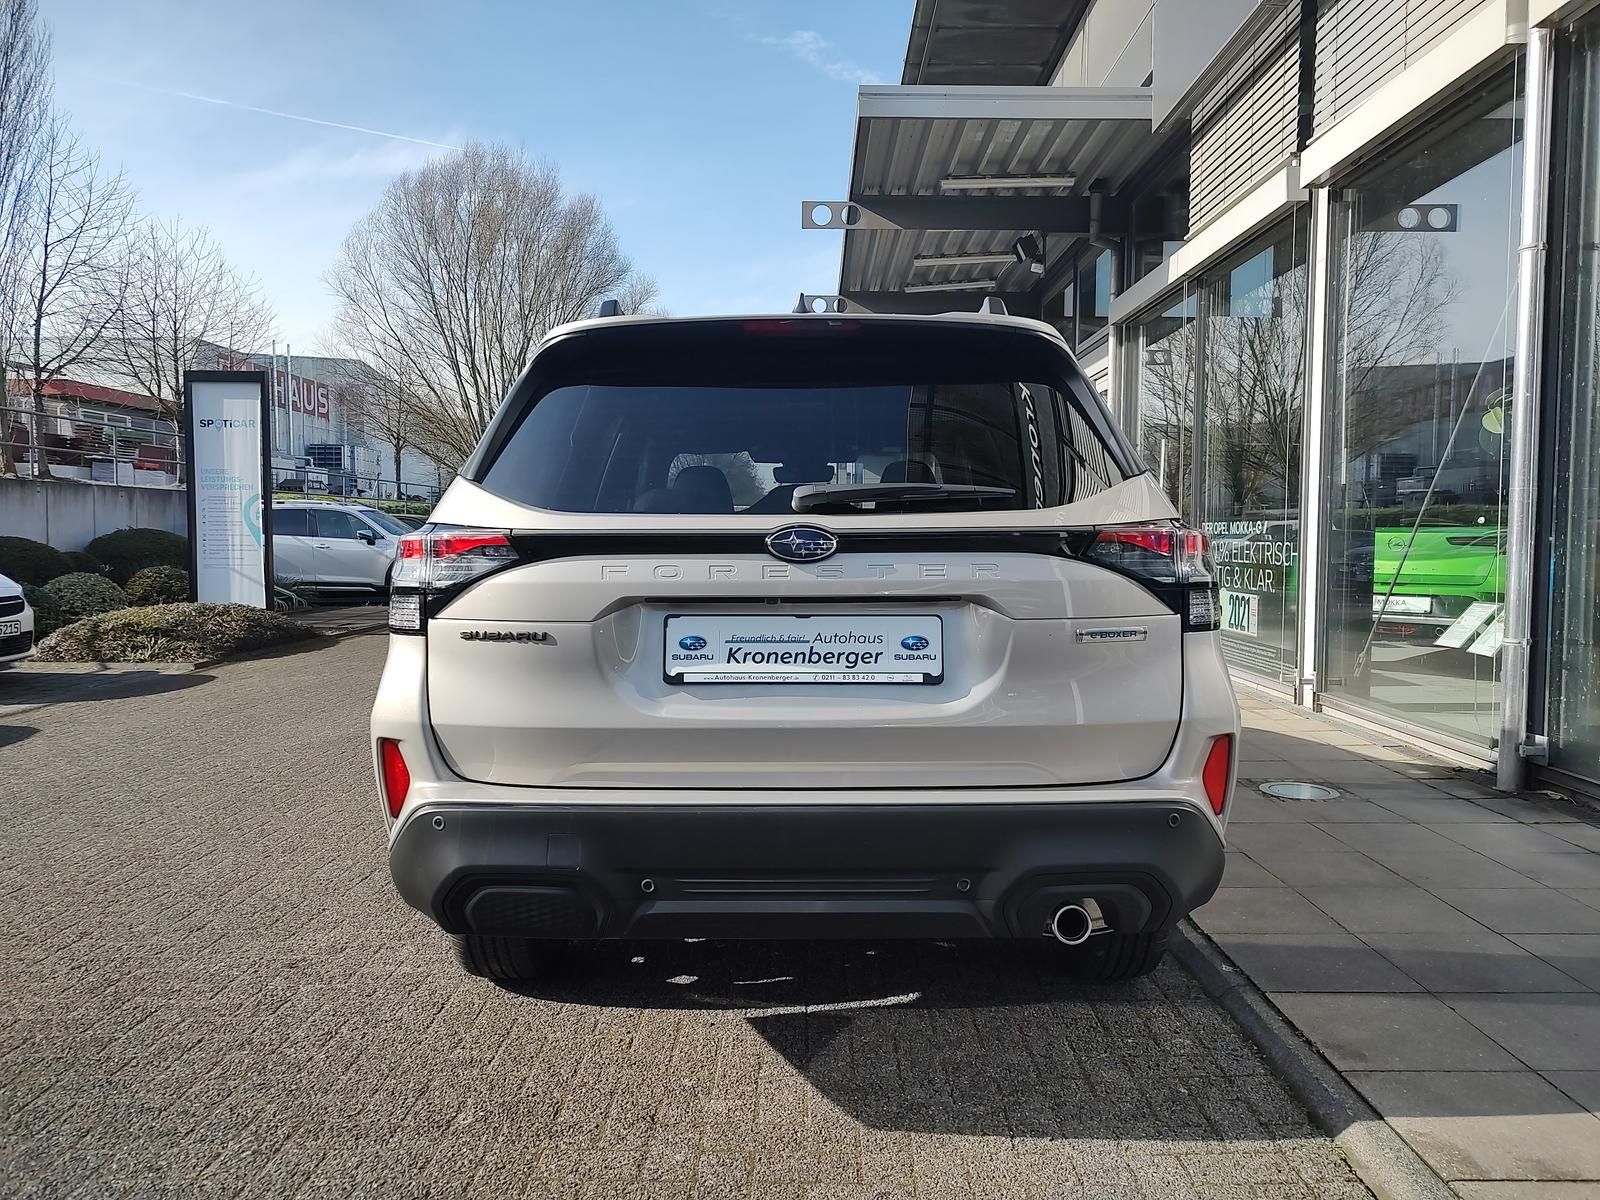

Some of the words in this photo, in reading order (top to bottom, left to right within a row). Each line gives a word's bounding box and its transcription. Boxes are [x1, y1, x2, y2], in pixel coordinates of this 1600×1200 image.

[1213, 522, 1228, 534] OPEL
[1231, 541, 1298, 566] ELEKTRISCH
[599, 564, 1001, 581] FORESTER
[1215, 565, 1231, 587] TIG
[1232, 566, 1241, 588] &
[1244, 567, 1275, 593] KLAR.
[1228, 593, 1250, 632] 2021
[460, 630, 547, 642] SUBARU
[731, 634, 776, 642] Freundlich
[787, 634, 805, 642] fair!
[812, 631, 884, 644] Autohaus
[671, 653, 714, 661] SUBARU
[726, 646, 884, 669] Kronenberger
[894, 653, 937, 661] SUBARU
